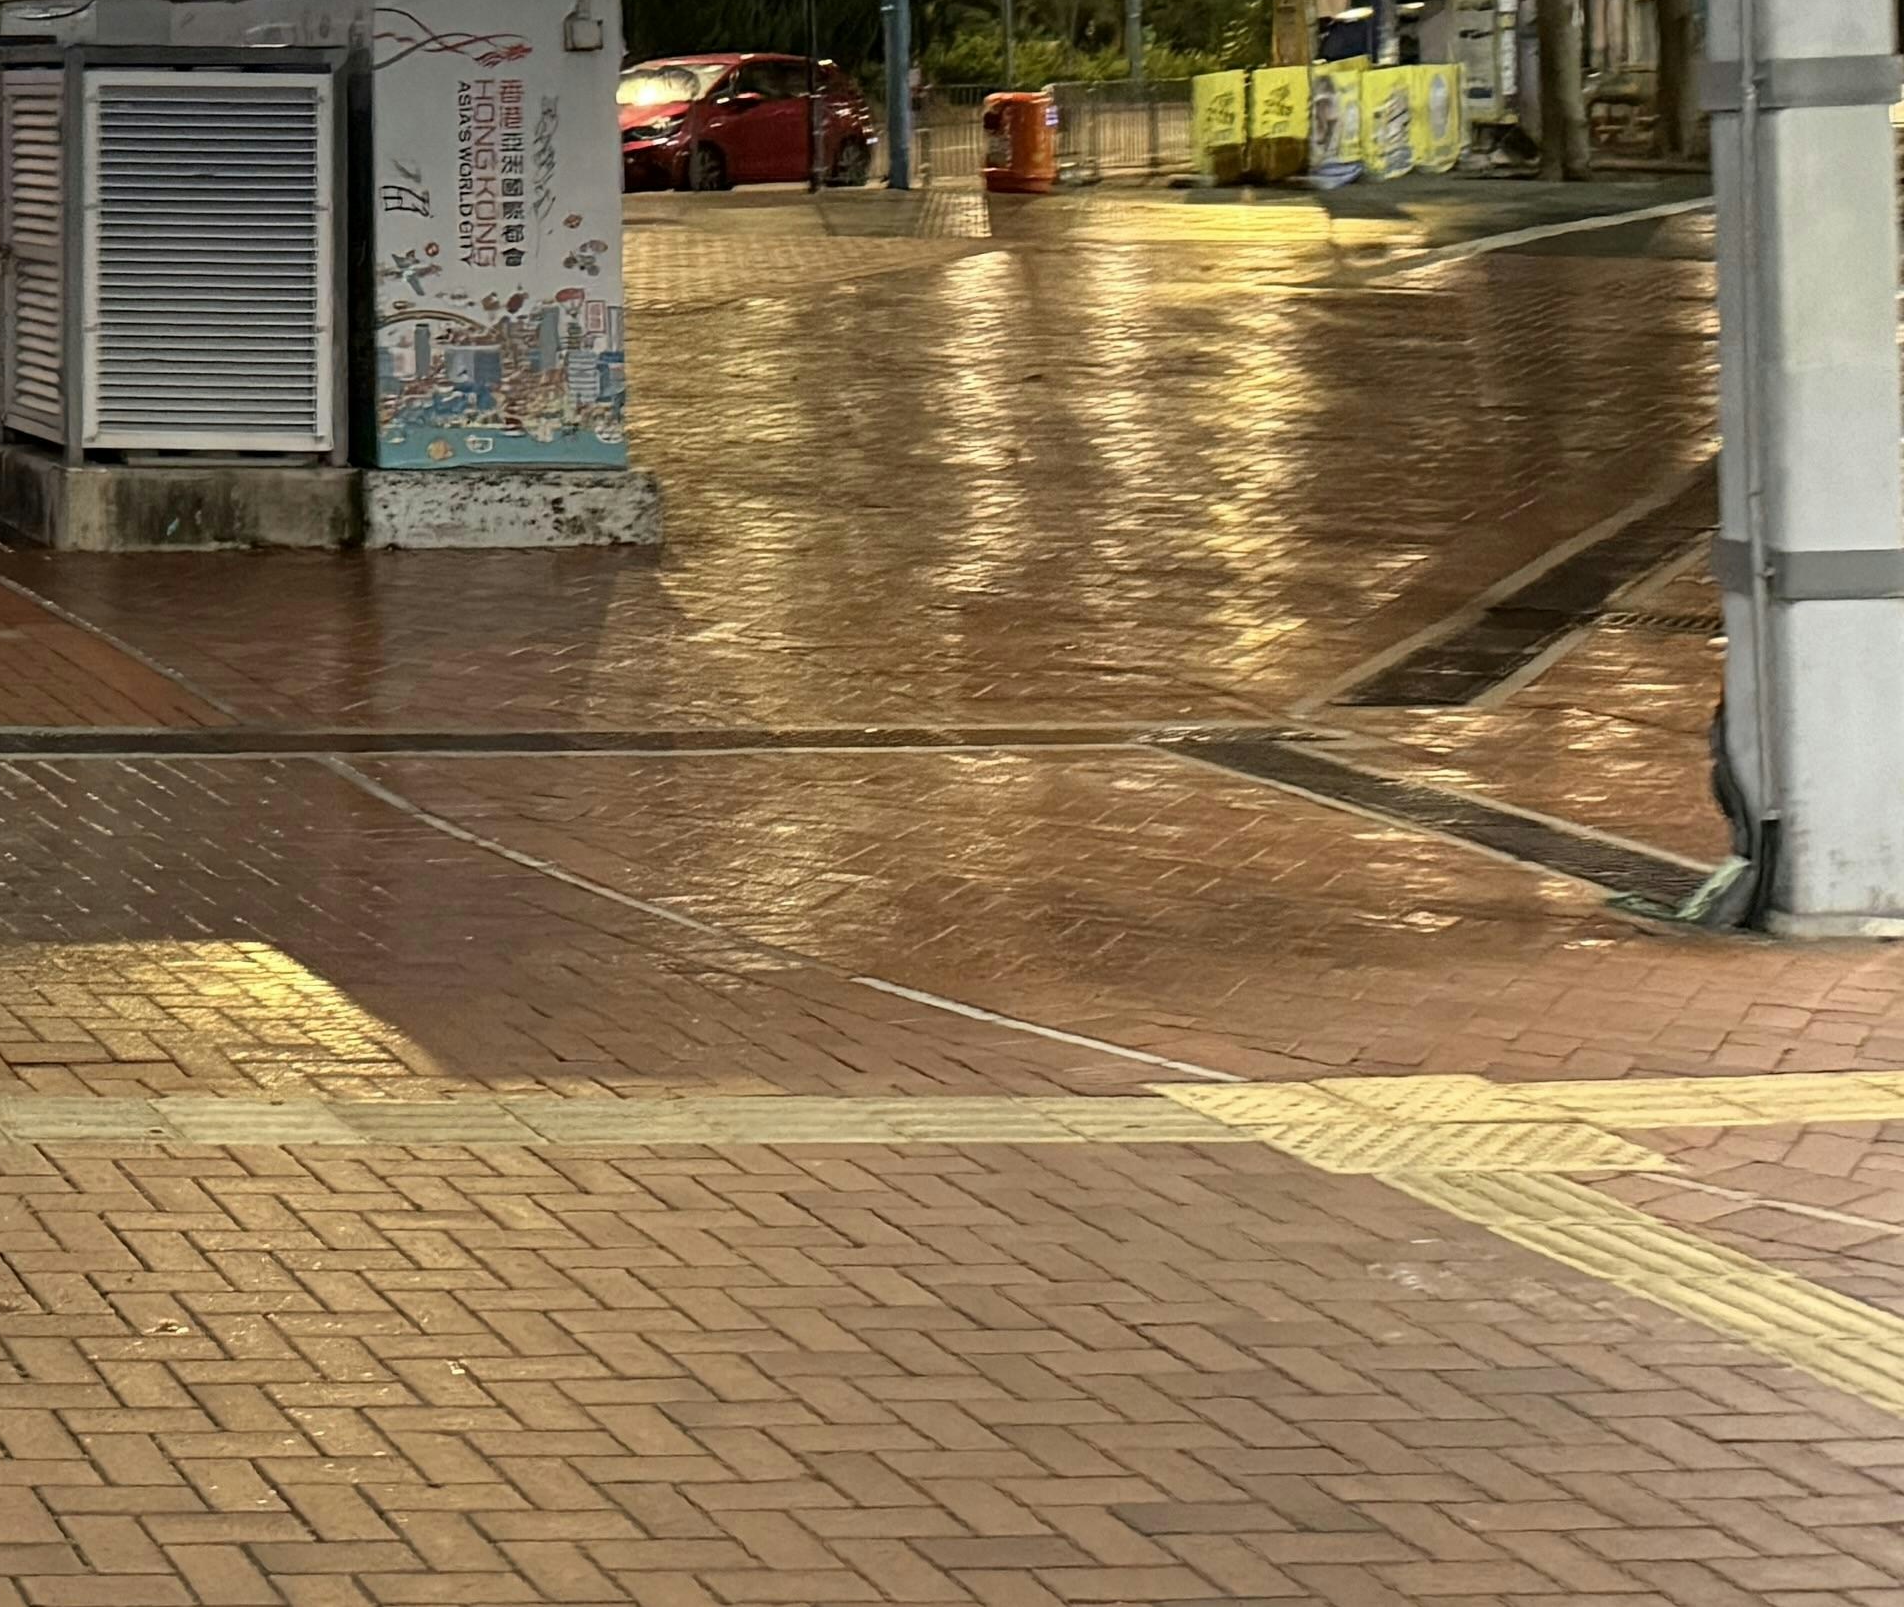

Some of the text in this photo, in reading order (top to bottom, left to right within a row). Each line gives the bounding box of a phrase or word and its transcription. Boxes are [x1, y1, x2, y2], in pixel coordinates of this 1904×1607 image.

[457, 80, 473, 267] ASIA'S WORLD CITY
[472, 79, 497, 268] HONG KONG
